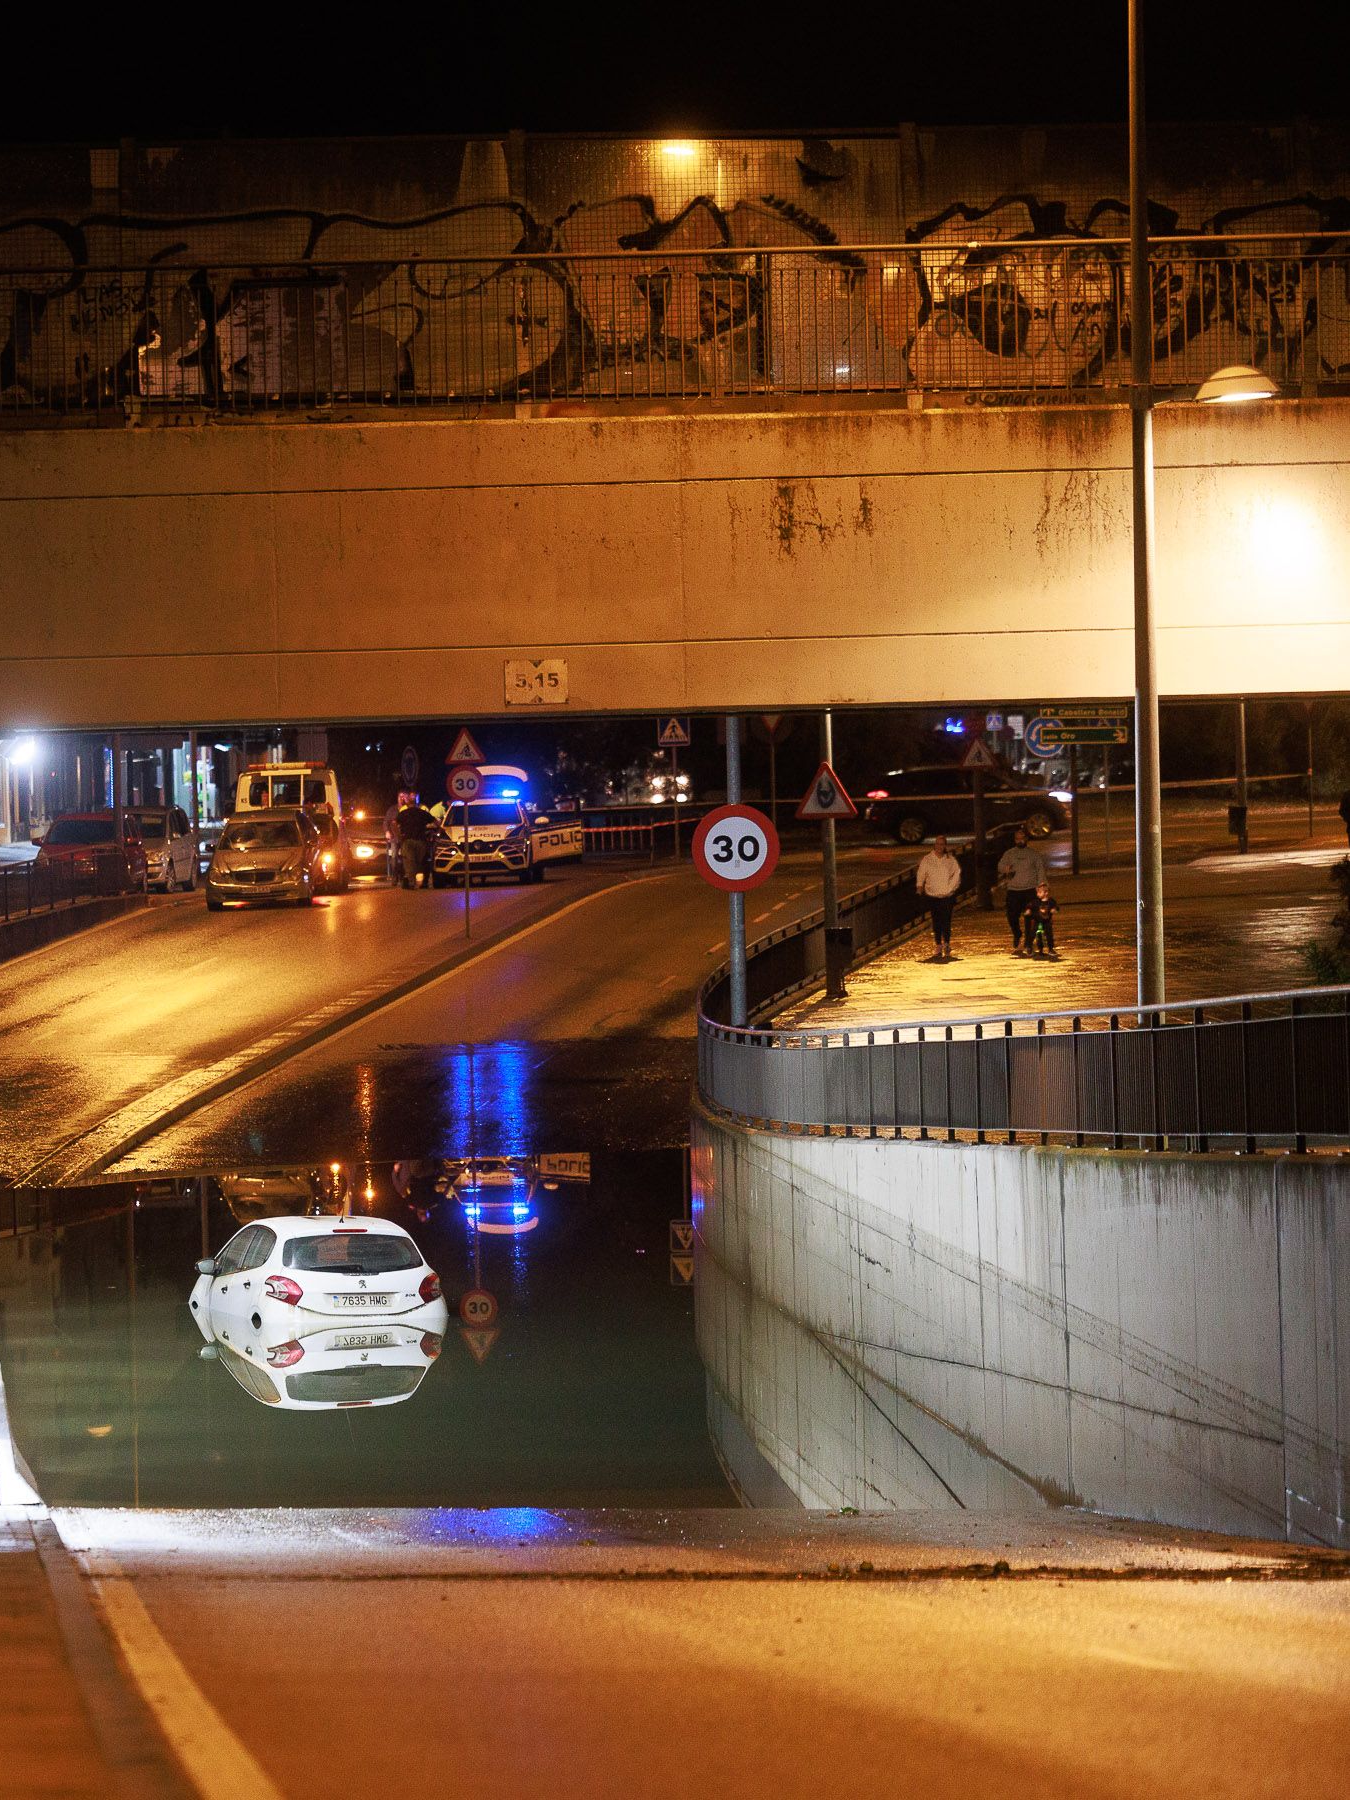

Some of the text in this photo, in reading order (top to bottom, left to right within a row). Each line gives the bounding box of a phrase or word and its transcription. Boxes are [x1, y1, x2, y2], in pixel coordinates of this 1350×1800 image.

[515, 672, 559, 691] 5,15
[455, 778, 476, 791] 30
[712, 835, 760, 863] 30
[342, 1296, 388, 1306] 7635 HMG
